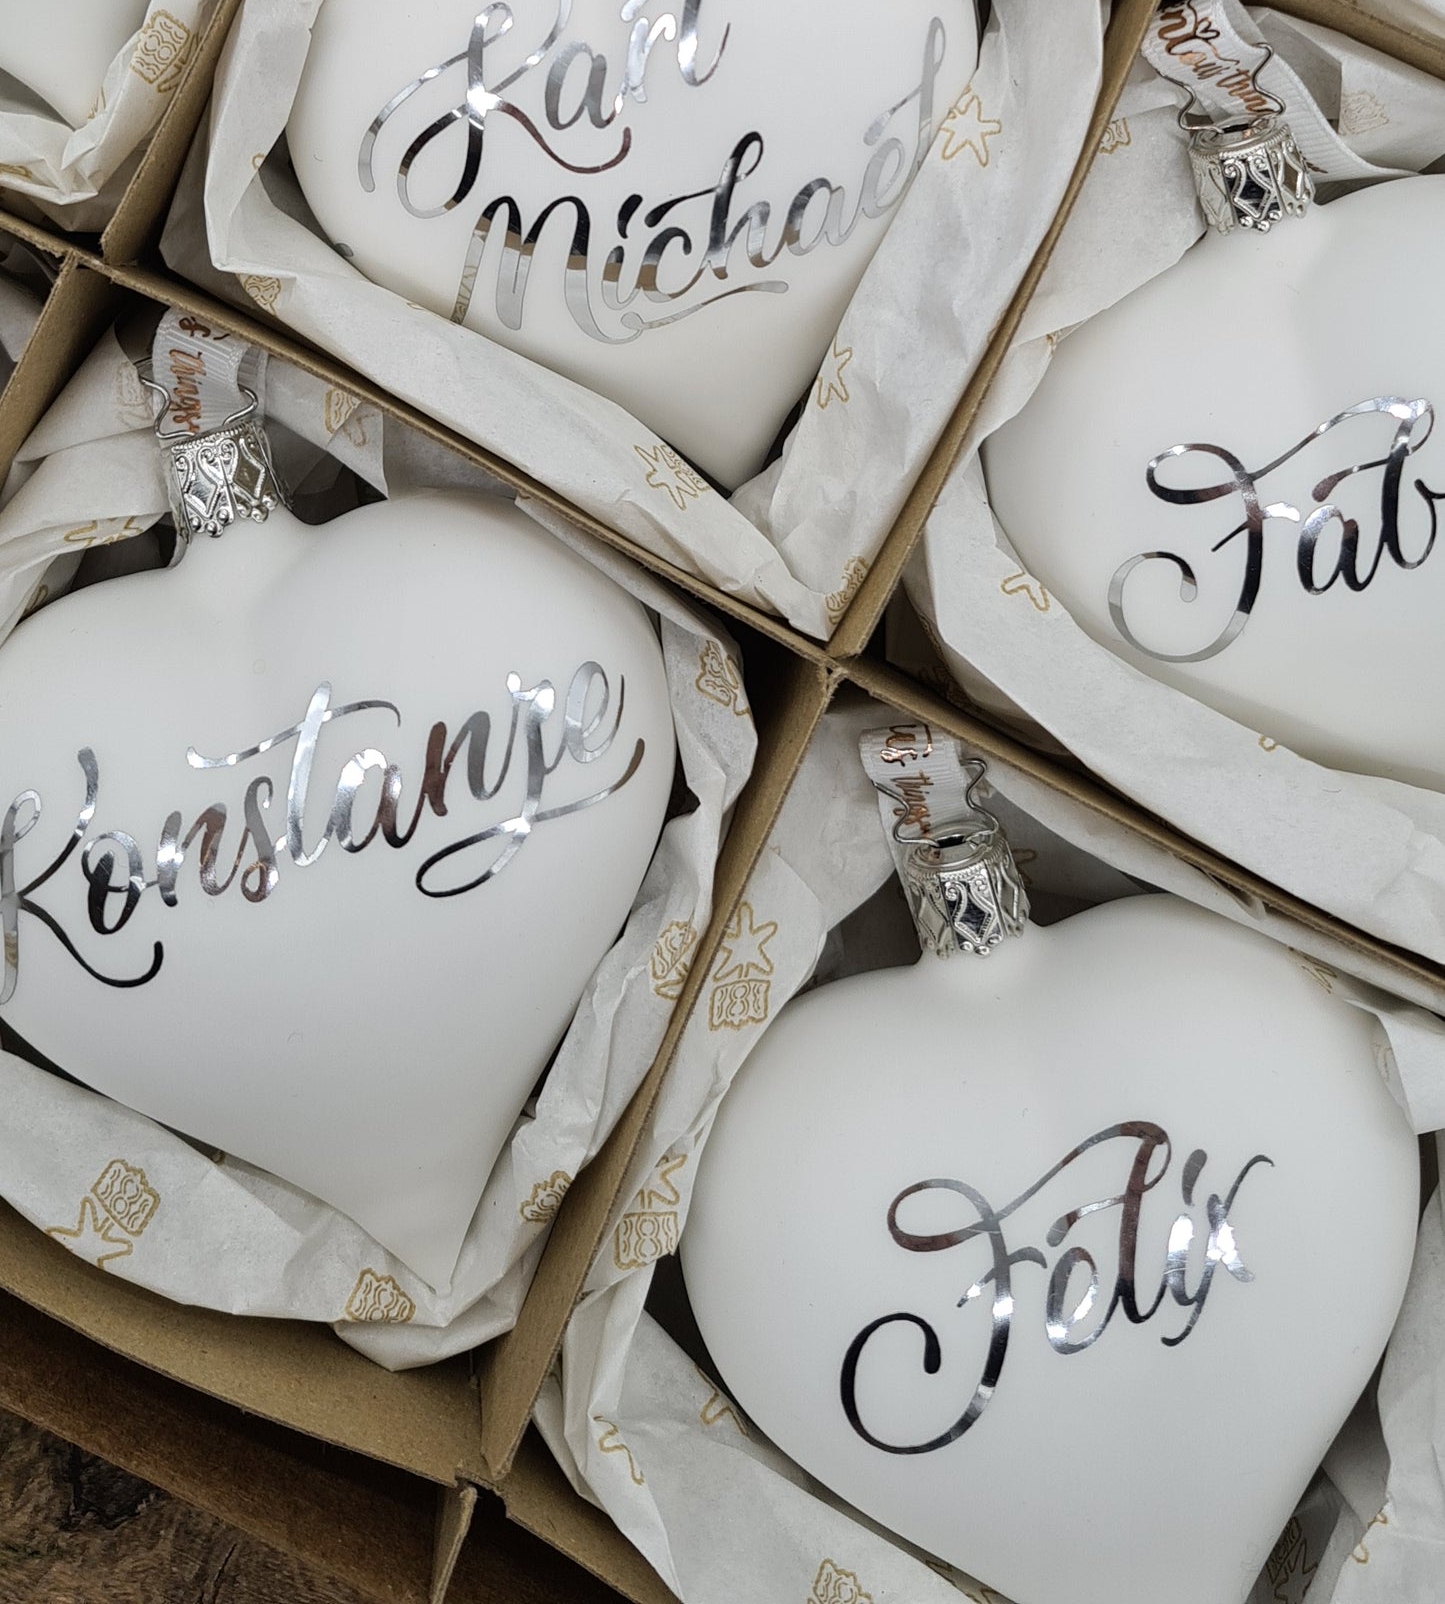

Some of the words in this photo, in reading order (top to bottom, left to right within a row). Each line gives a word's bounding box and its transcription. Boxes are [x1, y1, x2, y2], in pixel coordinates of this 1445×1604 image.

[449, 16, 947, 345] Michael
[1107, 396, 1445, 664] Fab
[0, 660, 645, 1005] Konstanze
[840, 1120, 1274, 1455] Felix
